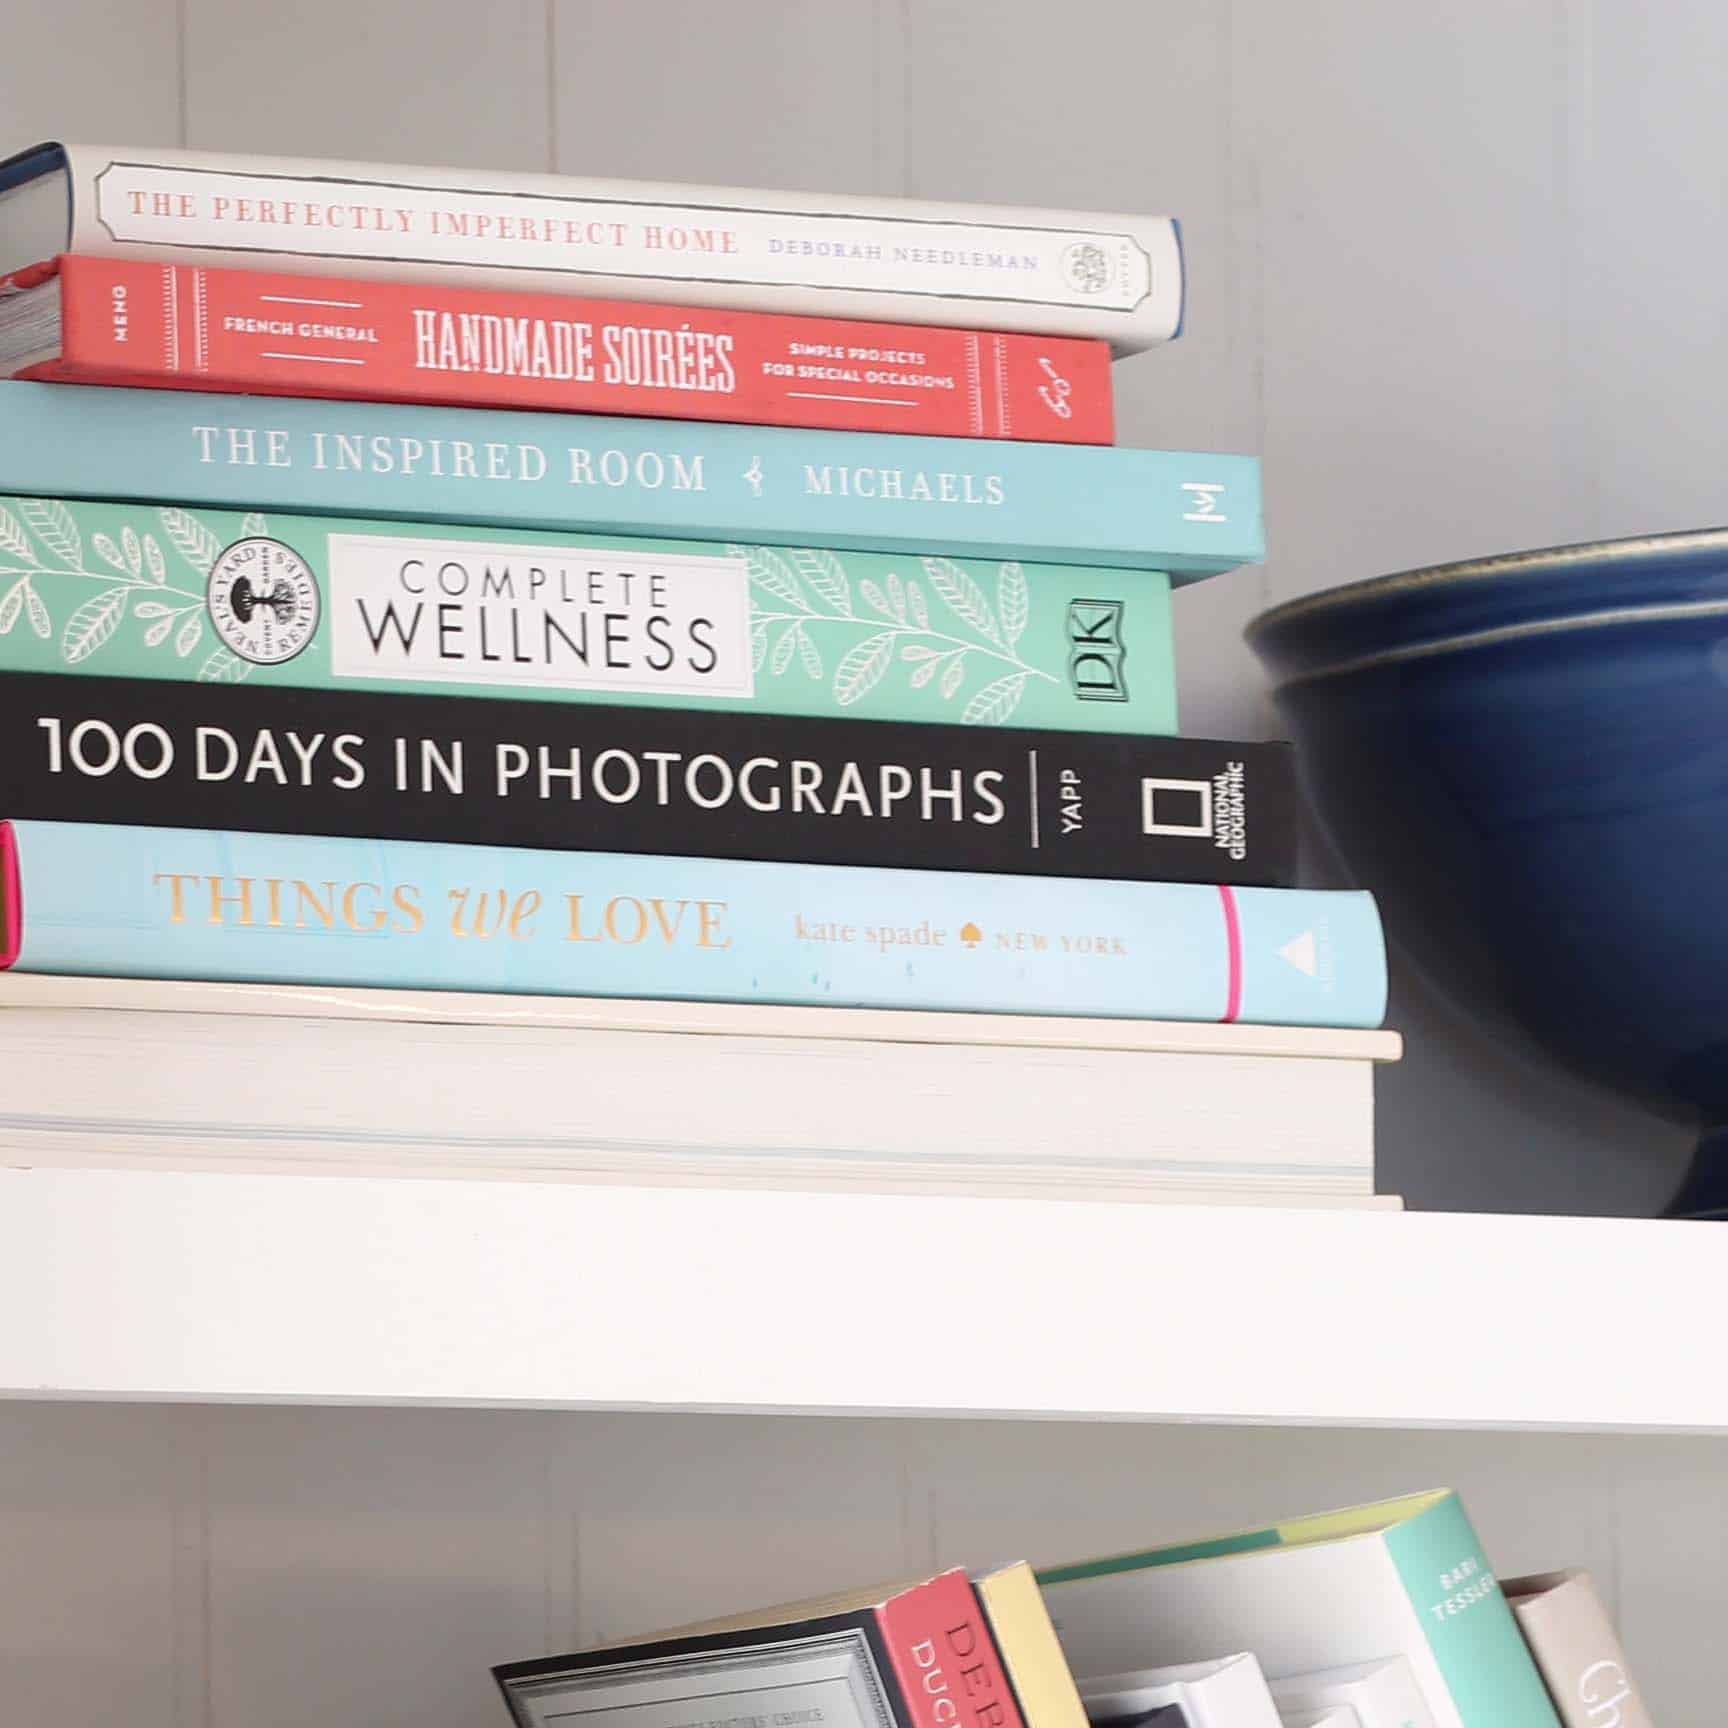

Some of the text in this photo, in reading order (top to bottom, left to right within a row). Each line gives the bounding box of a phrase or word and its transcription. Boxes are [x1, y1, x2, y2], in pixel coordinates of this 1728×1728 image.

[127, 190, 740, 254] THE PERFECTLY IMPERFECT HOME
[768, 238, 1039, 272] DEBORAH NEEDLEMAN
[224, 316, 379, 343] FRENCH GENERAL
[412, 310, 735, 393] HANDMADE SOIRÉES
[789, 342, 925, 365] SIMPLE PROJECTS
[762, 362, 954, 389] FOR SPECIAL OCCASIONS
[192, 427, 706, 491] THE INSPIRED ROOM
[805, 464, 1005, 505] MICHAELS
[400, 560, 667, 607] COMPLETE
[359, 598, 718, 673] WELLNESS
[1072, 612, 1121, 690] DK
[38, 717, 1003, 824] 100 DAYS IN PHOTOGRAPHS
[1062, 769, 1083, 833] YAPP
[153, 873, 732, 949] THINGS we LOVE
[795, 914, 947, 952] kate spade
[995, 933, 1126, 955] NEW YORK
